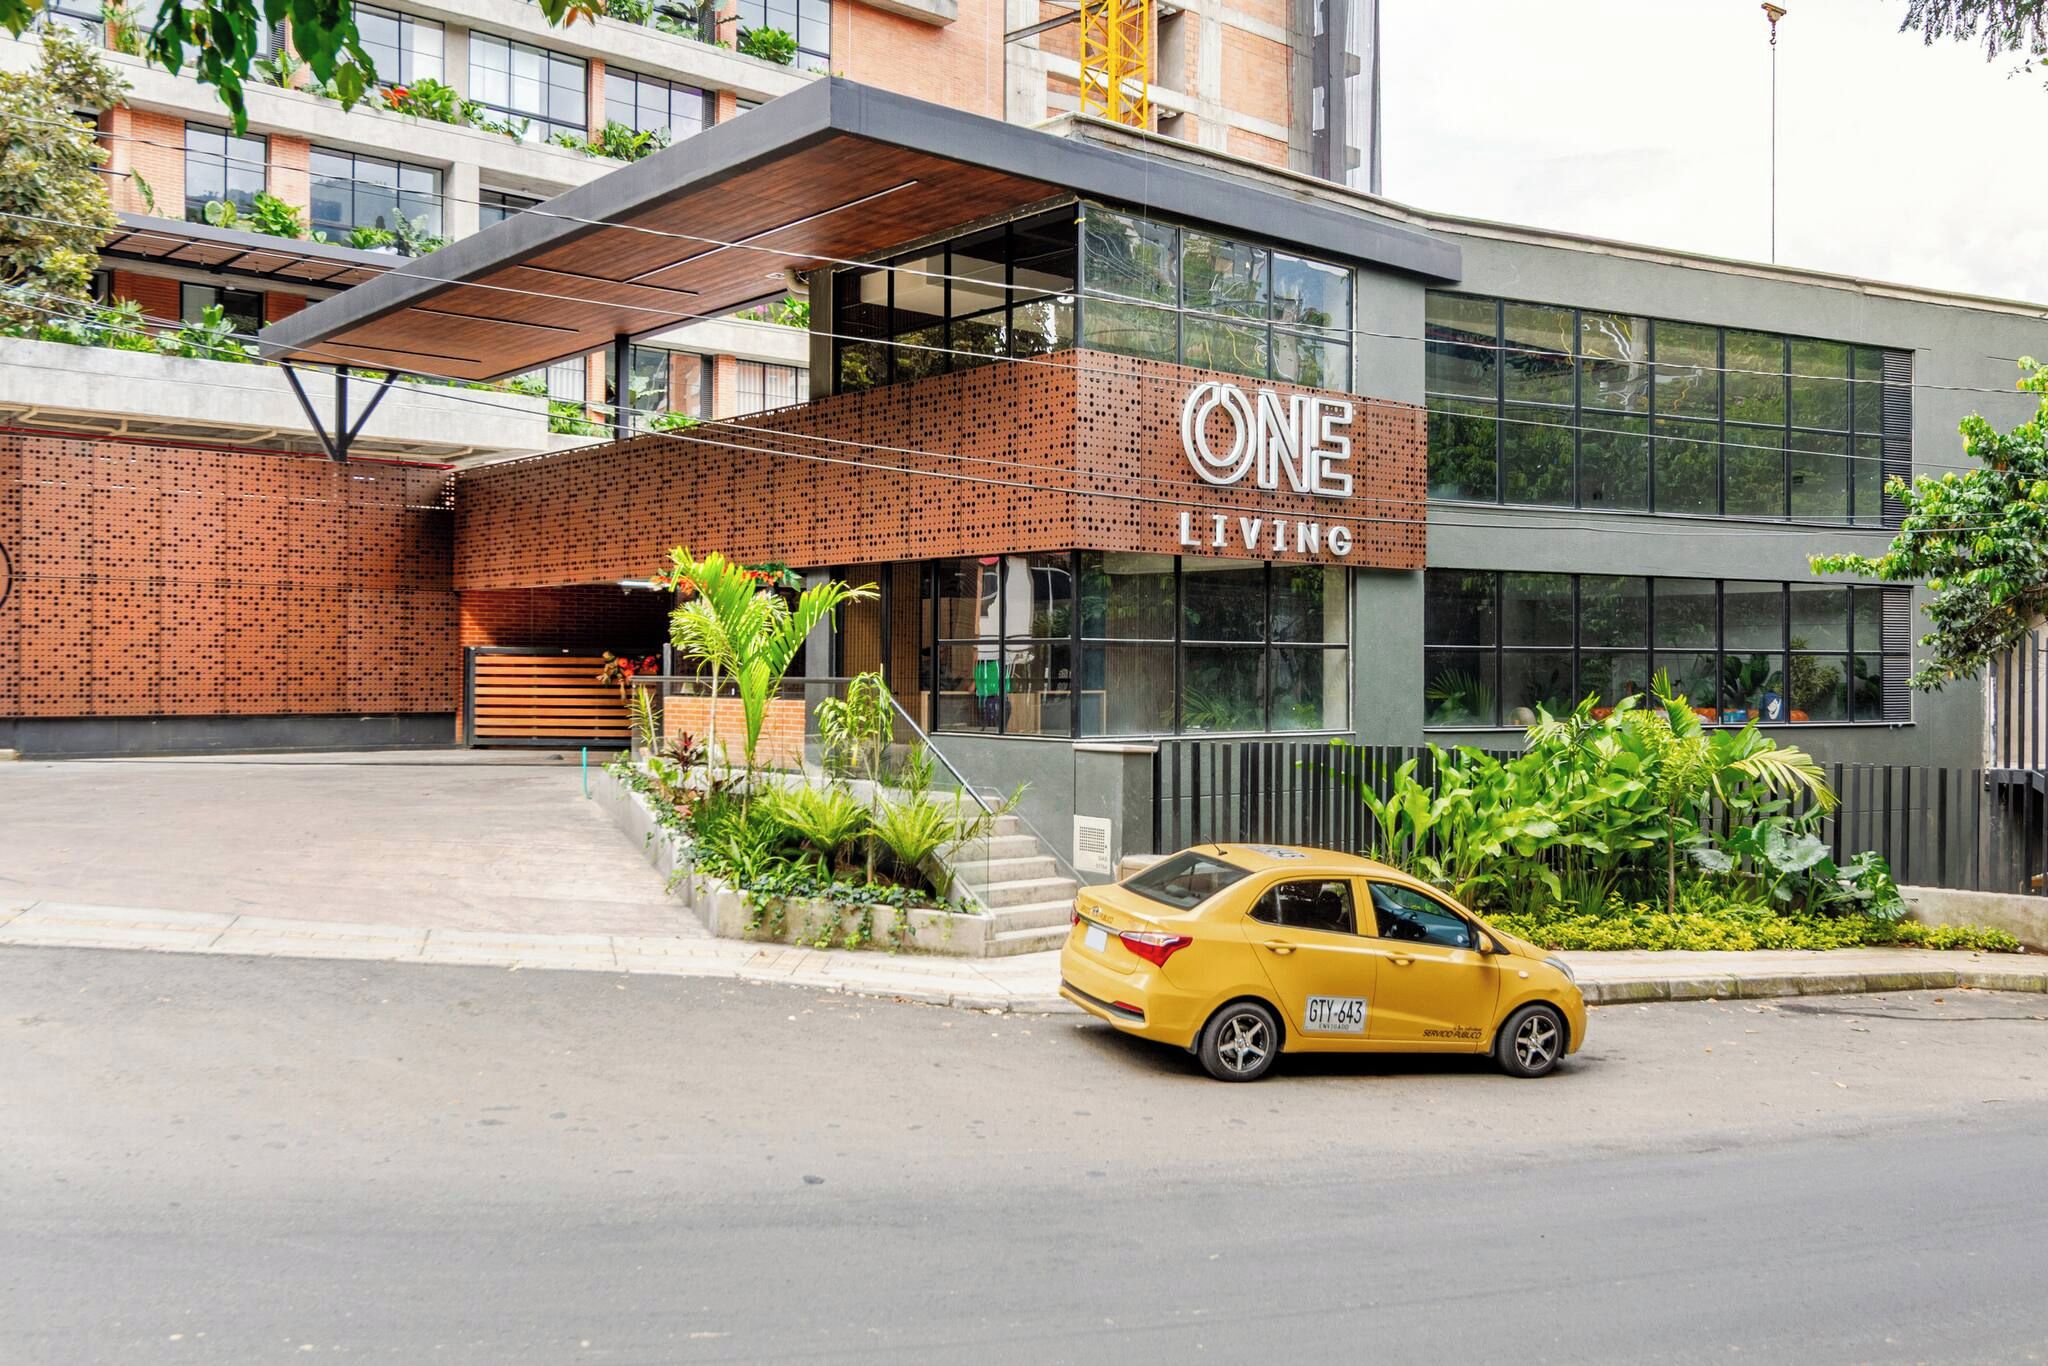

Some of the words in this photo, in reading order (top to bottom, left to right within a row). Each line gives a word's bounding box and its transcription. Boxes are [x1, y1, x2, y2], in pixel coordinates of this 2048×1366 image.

[1182, 381, 1353, 497] ONE
[1180, 512, 1353, 556] LIVING
[1309, 999, 1363, 1024] GTY-643
[1423, 1029, 1454, 1038] SERVICIO
